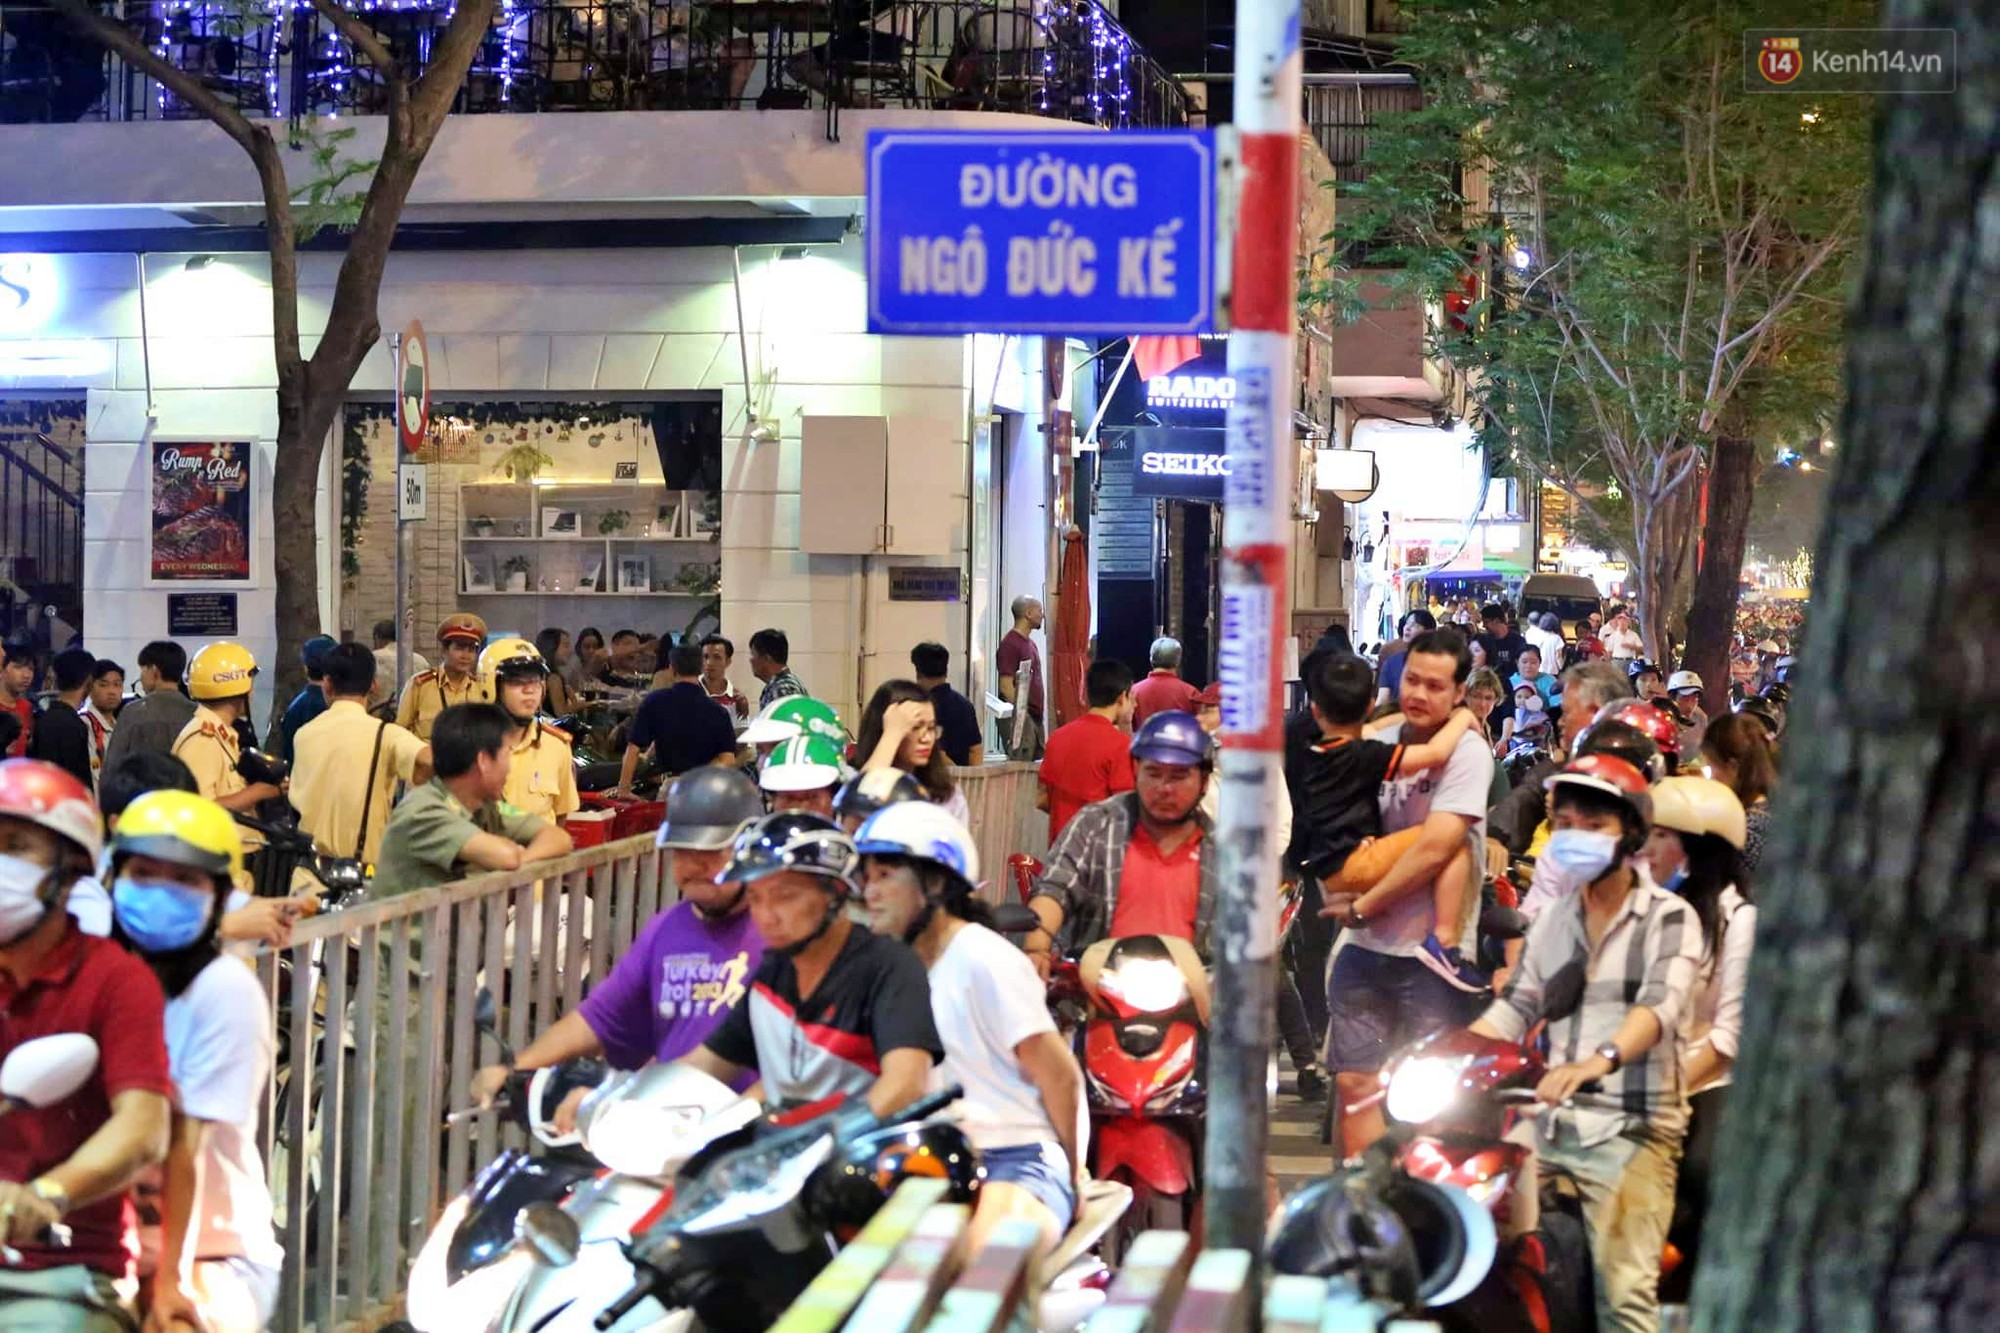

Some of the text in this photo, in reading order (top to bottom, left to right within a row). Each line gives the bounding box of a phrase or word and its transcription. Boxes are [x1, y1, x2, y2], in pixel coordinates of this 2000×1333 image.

[960, 152, 1138, 208] ĐƯỜNG
[901, 218, 1184, 297] NGÔ ĐỨC KẾ
[1147, 375, 1237, 399] RADO
[160, 447, 203, 473] Rump
[206, 457, 242, 481] Red
[406, 478, 421, 505] 50m
[213, 668, 247, 683] CSGT
